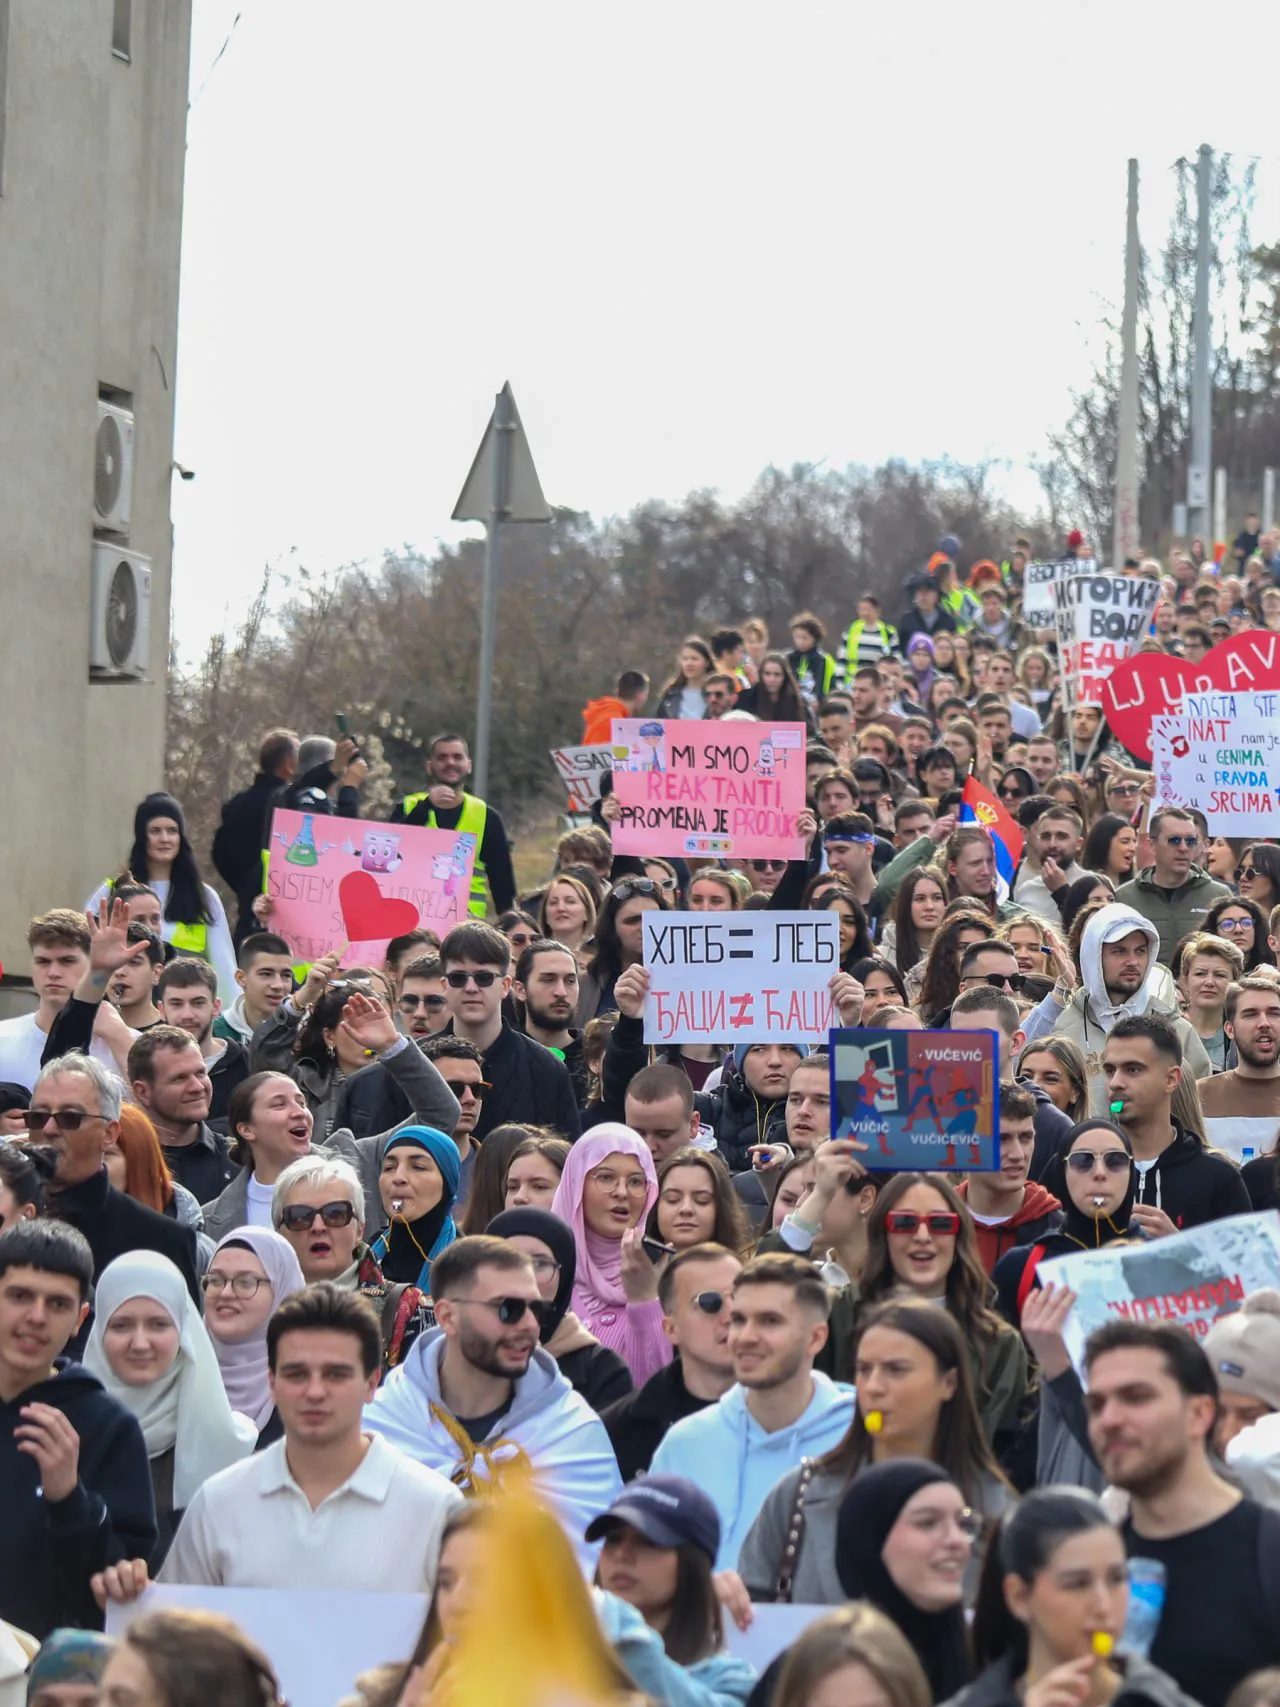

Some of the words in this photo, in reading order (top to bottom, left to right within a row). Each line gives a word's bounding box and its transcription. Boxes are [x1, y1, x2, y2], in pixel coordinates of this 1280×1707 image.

[1187, 719, 1231, 743] INAT
[1241, 731, 1265, 745] nam
[671, 745, 696, 769] MI
[704, 744, 750, 774] SMO
[1198, 753, 1208, 764] u
[1213, 771, 1269, 788] PRAVDA
[1207, 791, 1273, 814] SRCIMA
[619, 805, 708, 833] PROMENA
[712, 807, 730, 834] JE
[269, 869, 334, 905] SISTEM
[648, 924, 725, 965] ХЛЕБ
[771, 922, 835, 964] ЛЕБ
[650, 989, 726, 1040] ЂАЦИ
